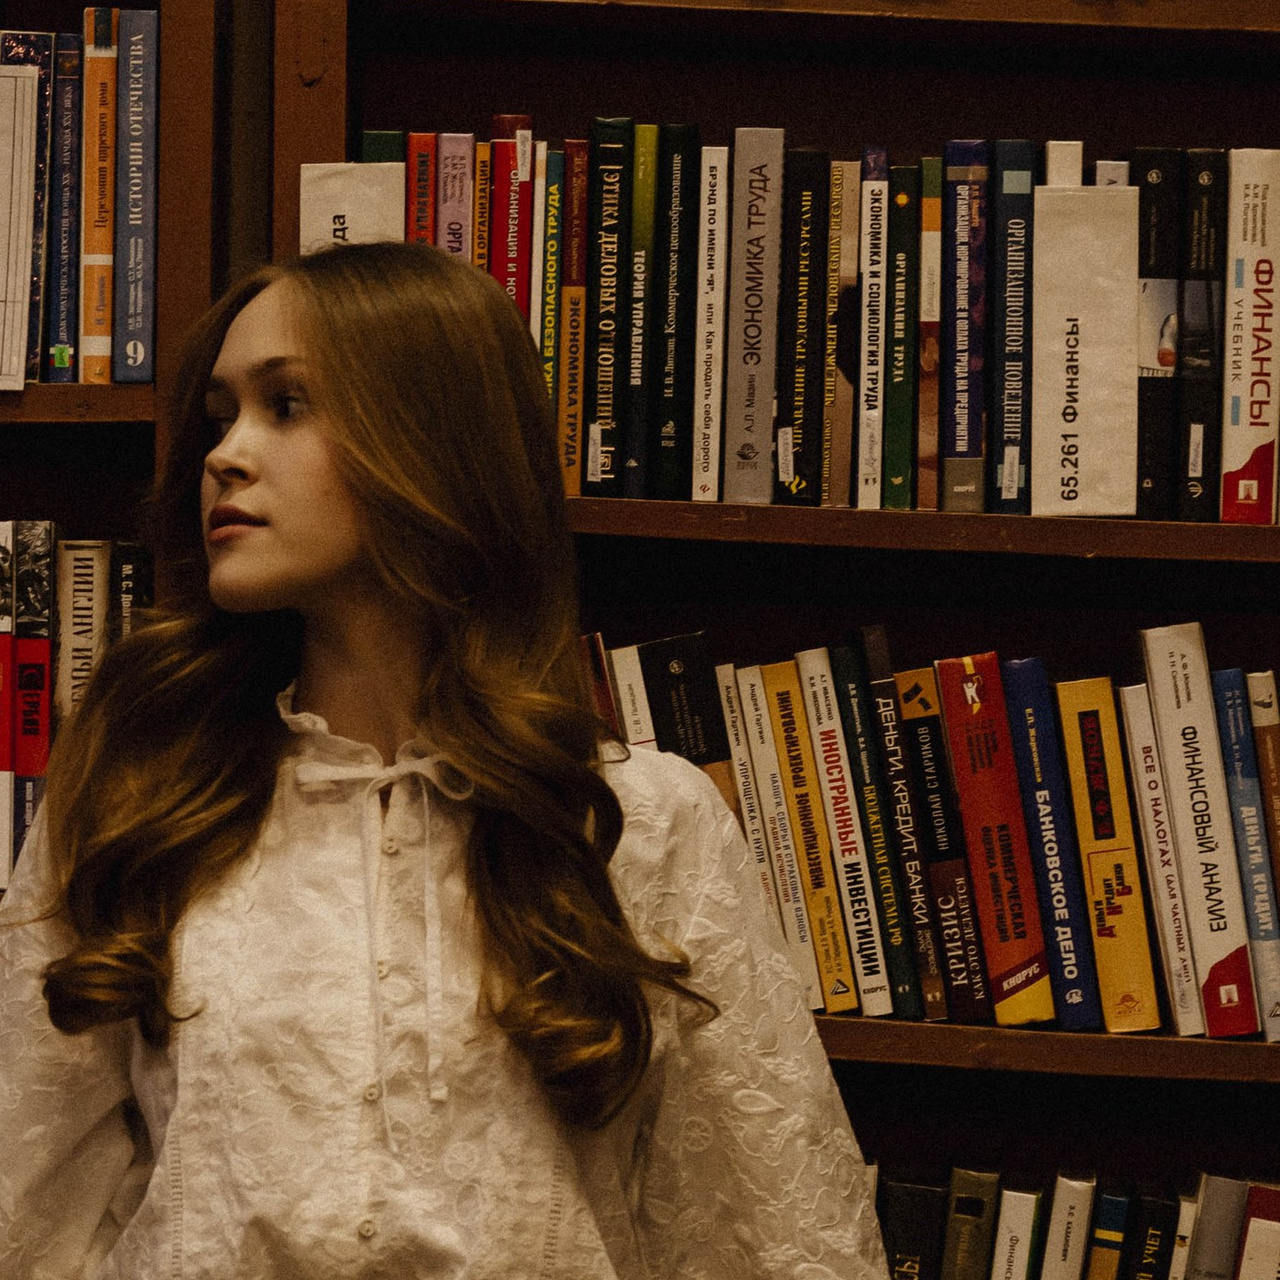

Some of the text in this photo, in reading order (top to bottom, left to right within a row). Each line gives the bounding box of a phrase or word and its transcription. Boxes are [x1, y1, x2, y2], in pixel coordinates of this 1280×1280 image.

[128, 33, 144, 225] ИСТОРИЯ ОТЕЧЕСТВА
[706, 166, 717, 205] БРЭНД
[706, 209, 716, 224] ПО
[705, 228, 716, 270] ИМЕНИ
[743, 164, 769, 366] ЭКОНОМИКА ТРУДА
[705, 303, 714, 324] или
[705, 331, 715, 350] Как
[1231, 299, 1244, 383] УЧЕБНИК
[1249, 259, 1274, 427] ФИНАНСЫ
[701, 354, 714, 400] продать
[703, 404, 714, 429] себя
[1061, 317, 1081, 501] 65.261 Финансы
[699, 433, 712, 472] дорого
[72, 556, 94, 639] АНГЛИИ
[875, 697, 929, 925] ДЕНЬГИ, КРЕДИТ, БАНКИ
[915, 725, 951, 850] НИКОЛАЙ СТАРИКОВ
[1181, 726, 1227, 933] ФИНАНСОВЫЙ АНАЛИЗ
[819, 729, 881, 977] ИНОСТРАННЫЕ ИНВЕСТИЦИИ
[1035, 789, 1079, 981] БАНКОВСКОЕ ДЕЛО
[936, 893, 969, 986] КРИЗИС
